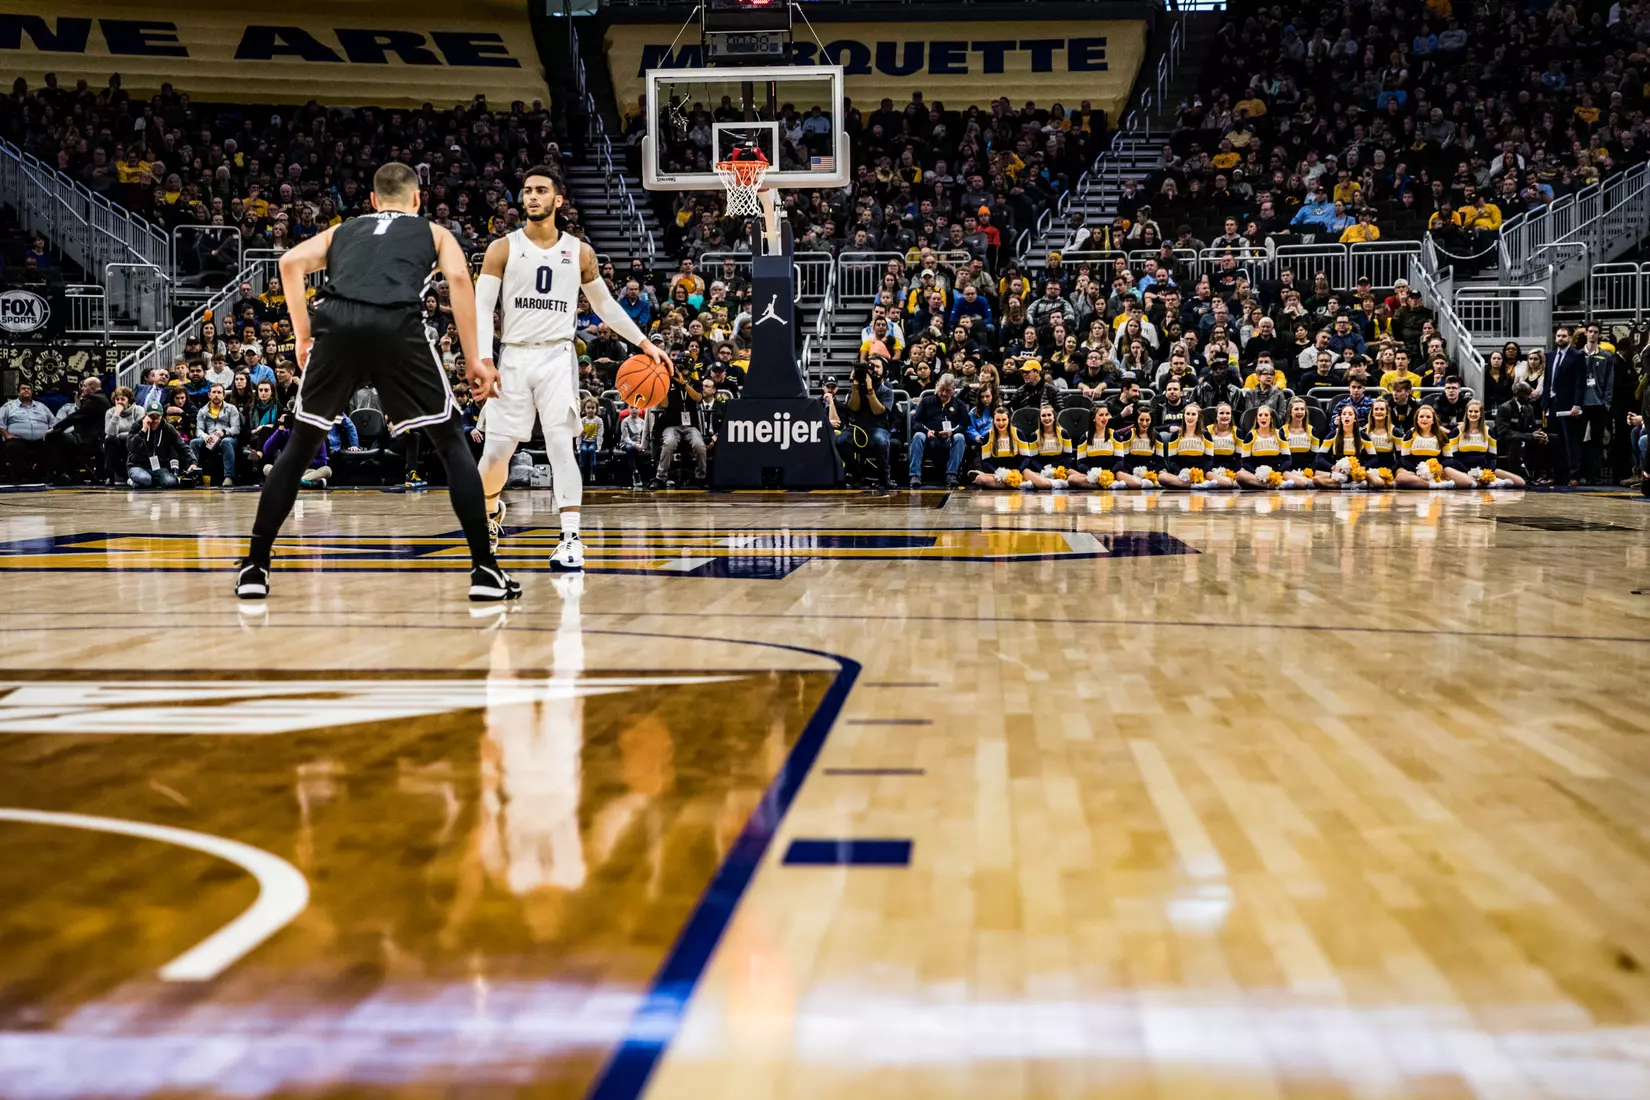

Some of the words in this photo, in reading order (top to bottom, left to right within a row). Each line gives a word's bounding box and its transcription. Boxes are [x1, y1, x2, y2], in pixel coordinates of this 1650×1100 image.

[234, 26, 522, 68] ARE
[638, 37, 1108, 78] MRQUETTE
[373, 219, 393, 235] 1
[535, 265, 553, 294] 0
[1, 298, 37, 316] FOX
[514, 297, 568, 313] MARQUETTE
[1, 316, 37, 324] SPORTS
[727, 412, 823, 450] meijer
